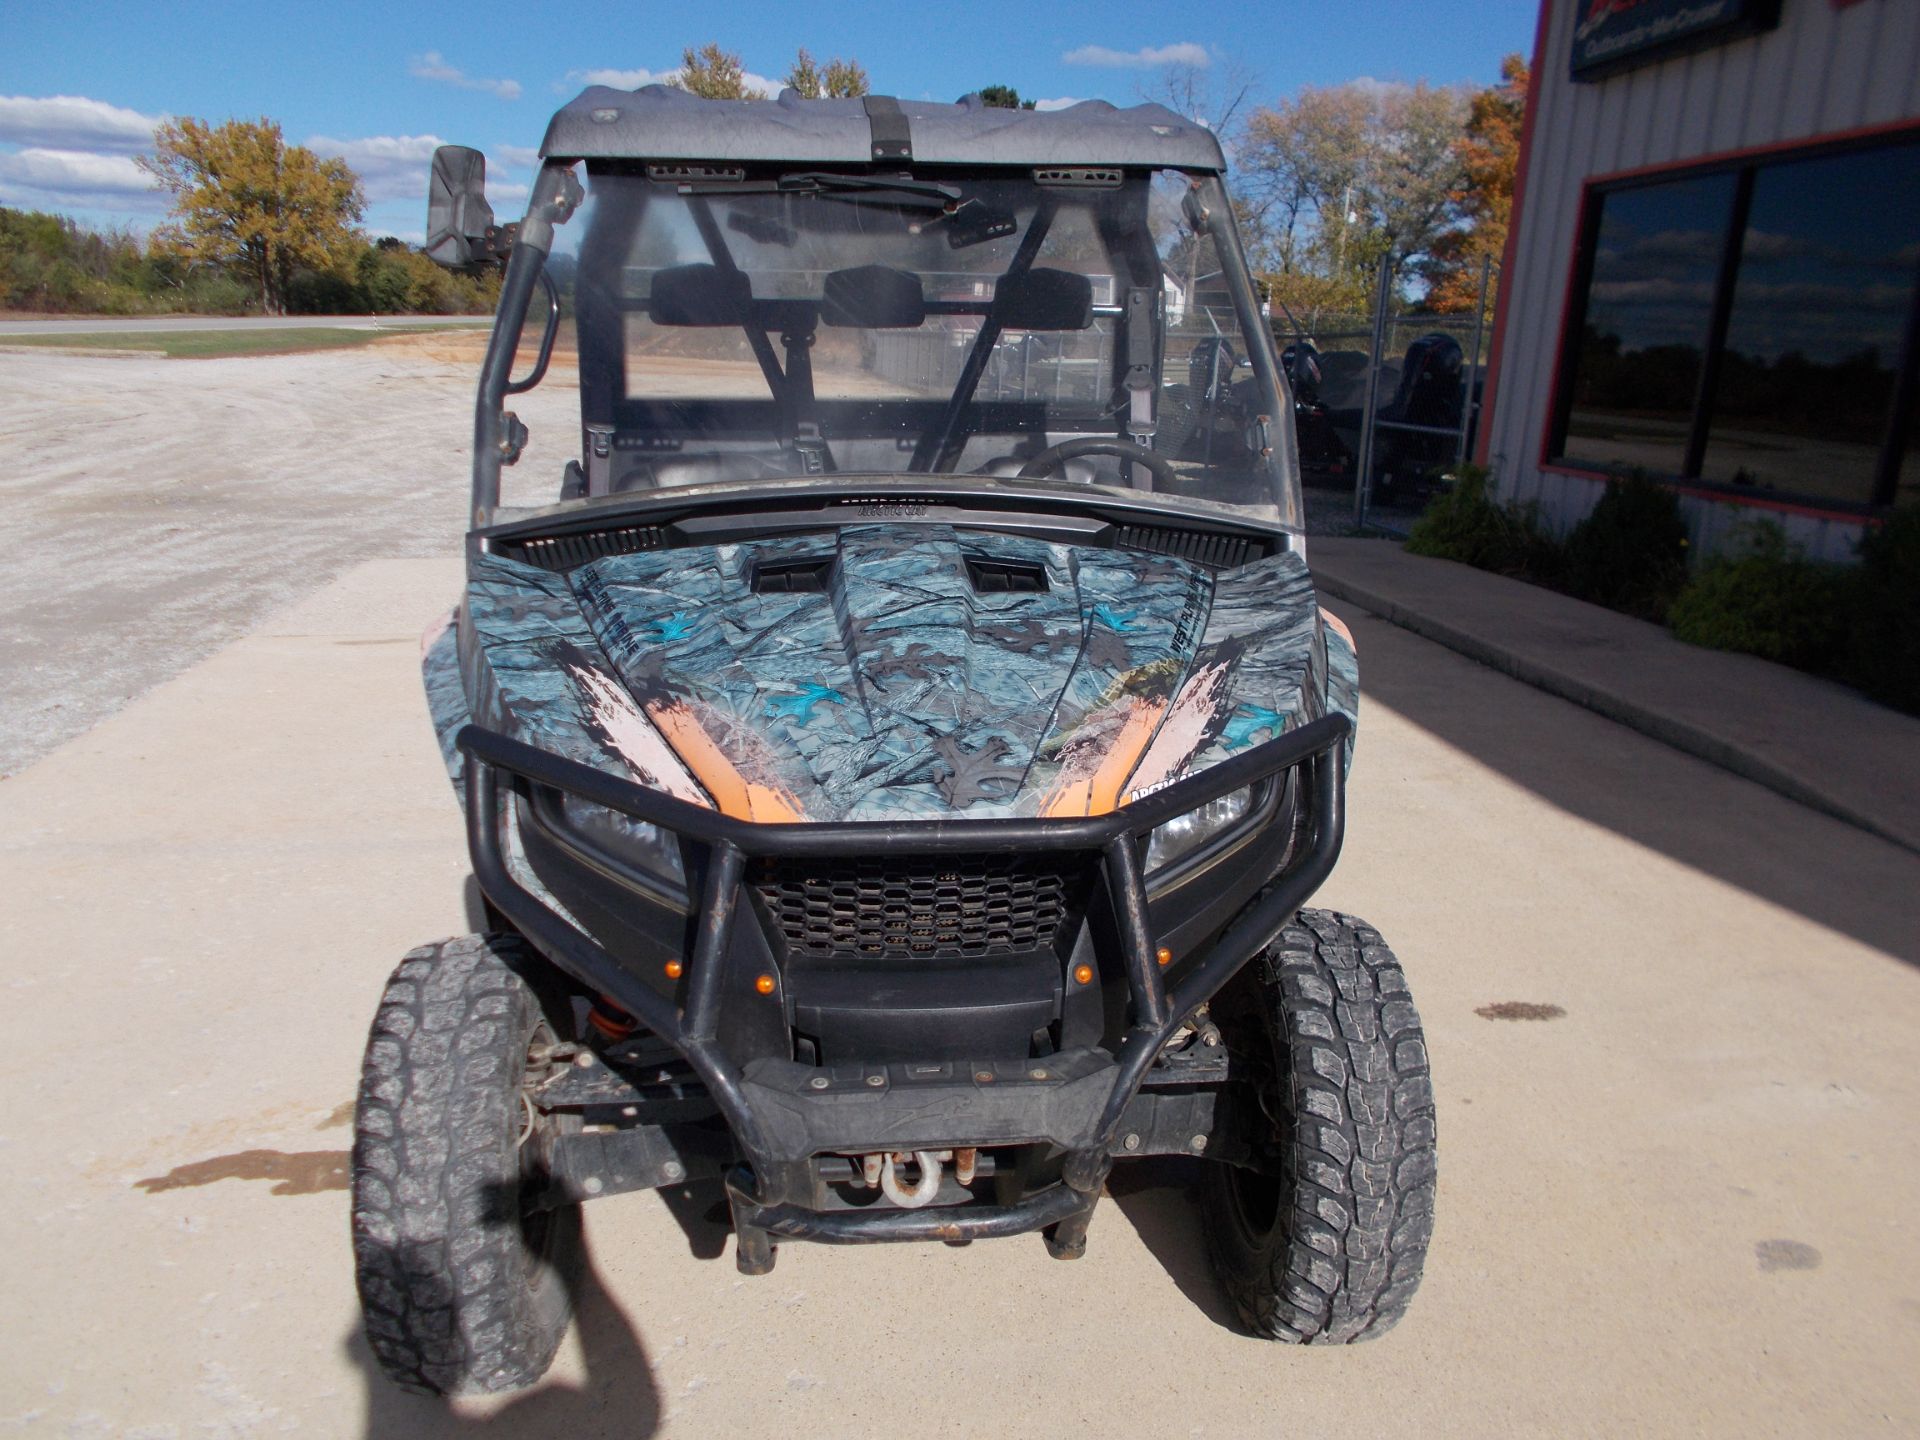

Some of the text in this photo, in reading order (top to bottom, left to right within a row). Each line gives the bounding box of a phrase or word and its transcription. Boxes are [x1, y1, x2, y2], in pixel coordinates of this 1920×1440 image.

[857, 504, 927, 516] ARCTIC CAT
[1170, 622, 1188, 653] WEST
